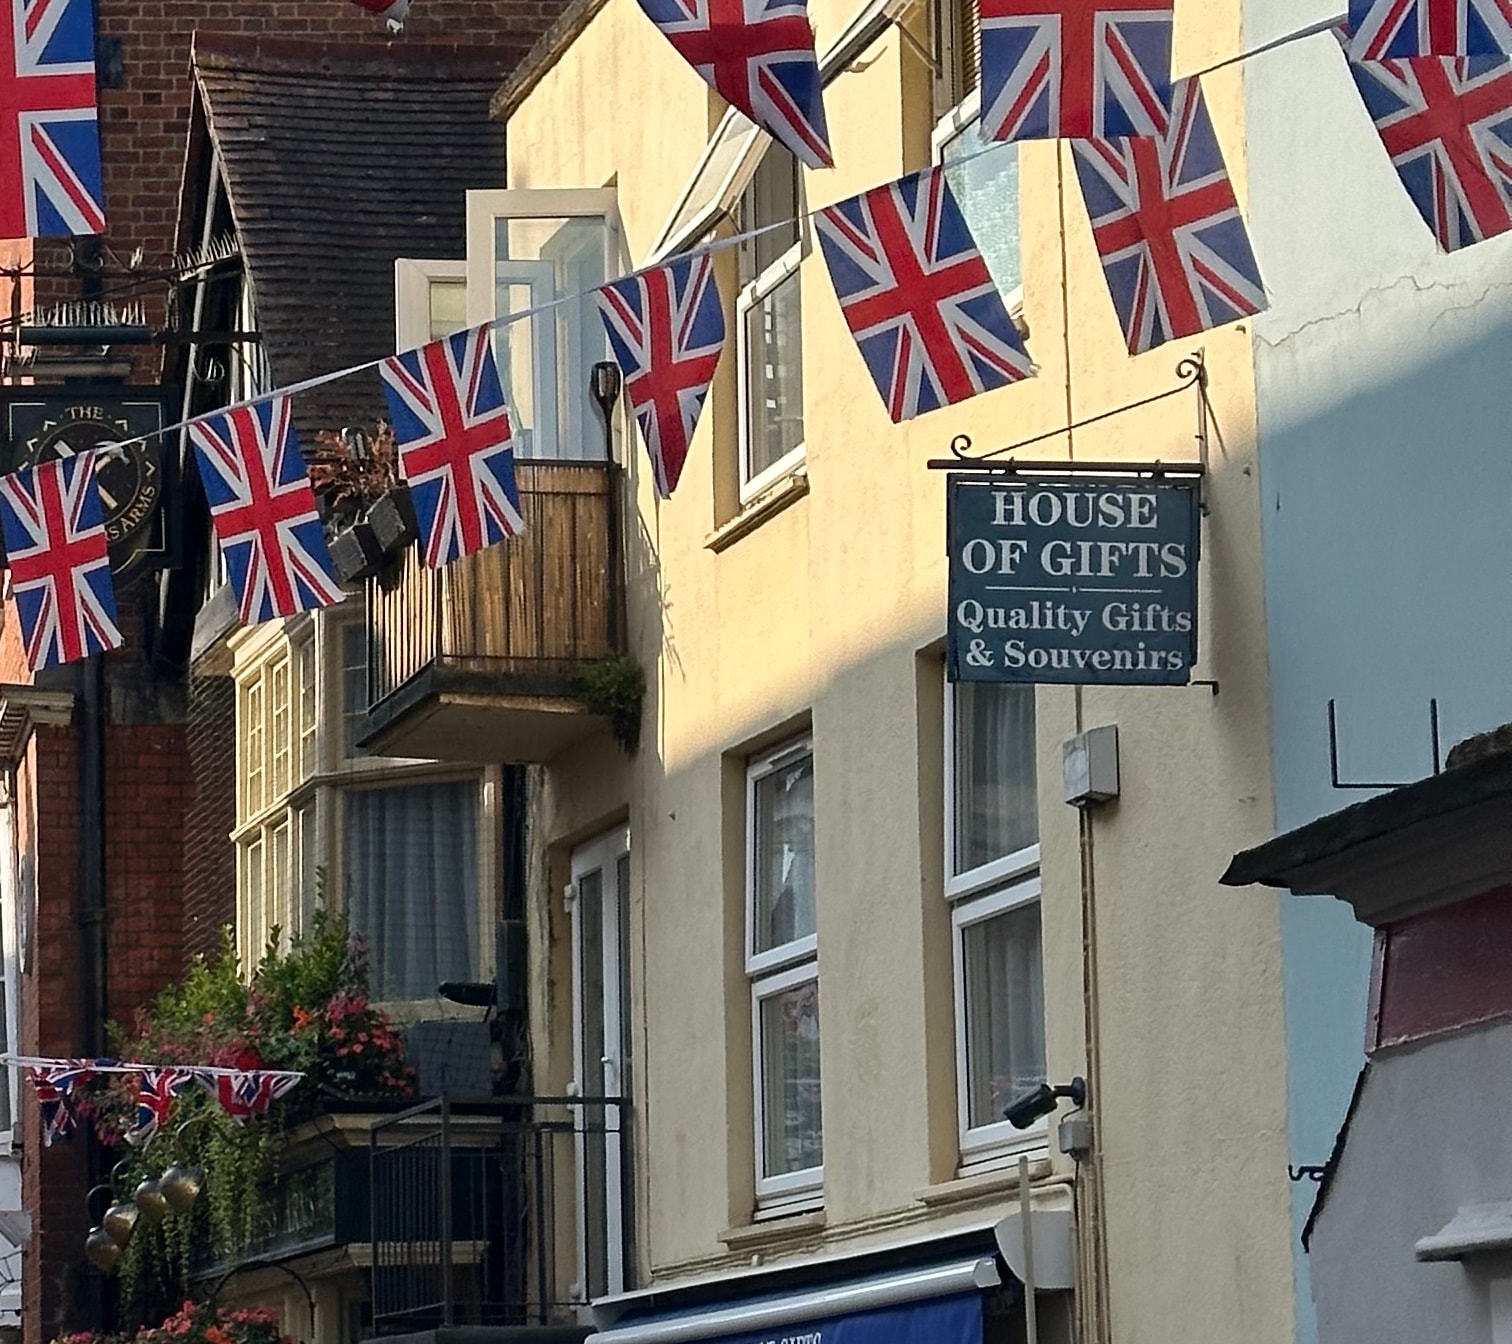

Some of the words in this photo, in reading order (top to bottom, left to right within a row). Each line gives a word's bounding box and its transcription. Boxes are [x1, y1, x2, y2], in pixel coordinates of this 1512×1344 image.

[65, 406, 104, 420] THE
[121, 486, 155, 533] ARMS
[991, 491, 1158, 528] HOUSE
[962, 539, 1028, 574] OF
[1041, 541, 1187, 577] GIFTS
[957, 600, 1092, 636] Quality
[1102, 602, 1192, 632] Gifts
[966, 639, 994, 666] &
[1004, 640, 1184, 670] Souvenirs
